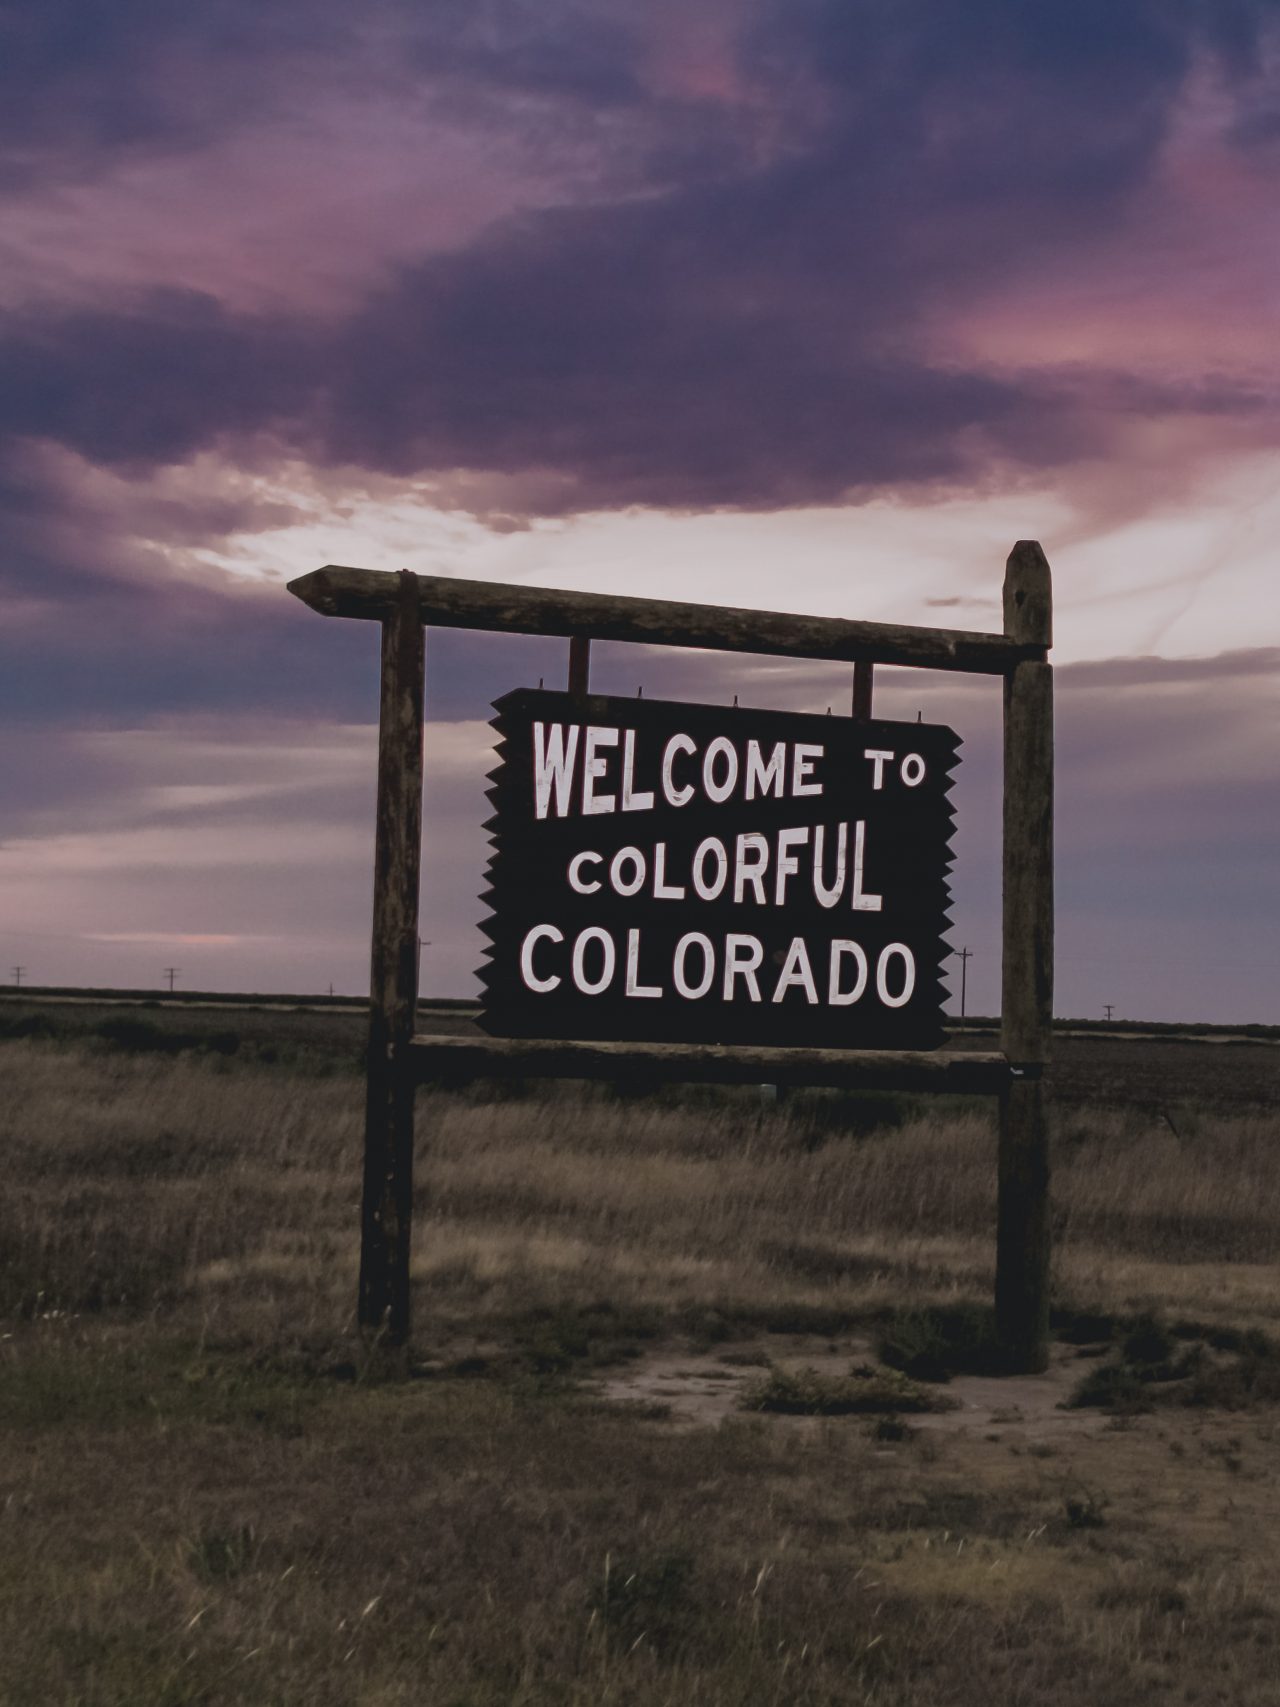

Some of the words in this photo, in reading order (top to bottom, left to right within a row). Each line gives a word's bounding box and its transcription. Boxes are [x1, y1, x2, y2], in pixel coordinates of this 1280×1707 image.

[533, 721, 824, 819] WELCOME
[864, 749, 926, 791] TO
[568, 820, 882, 912] COLORFUL
[520, 923, 916, 1008] COLORADO
